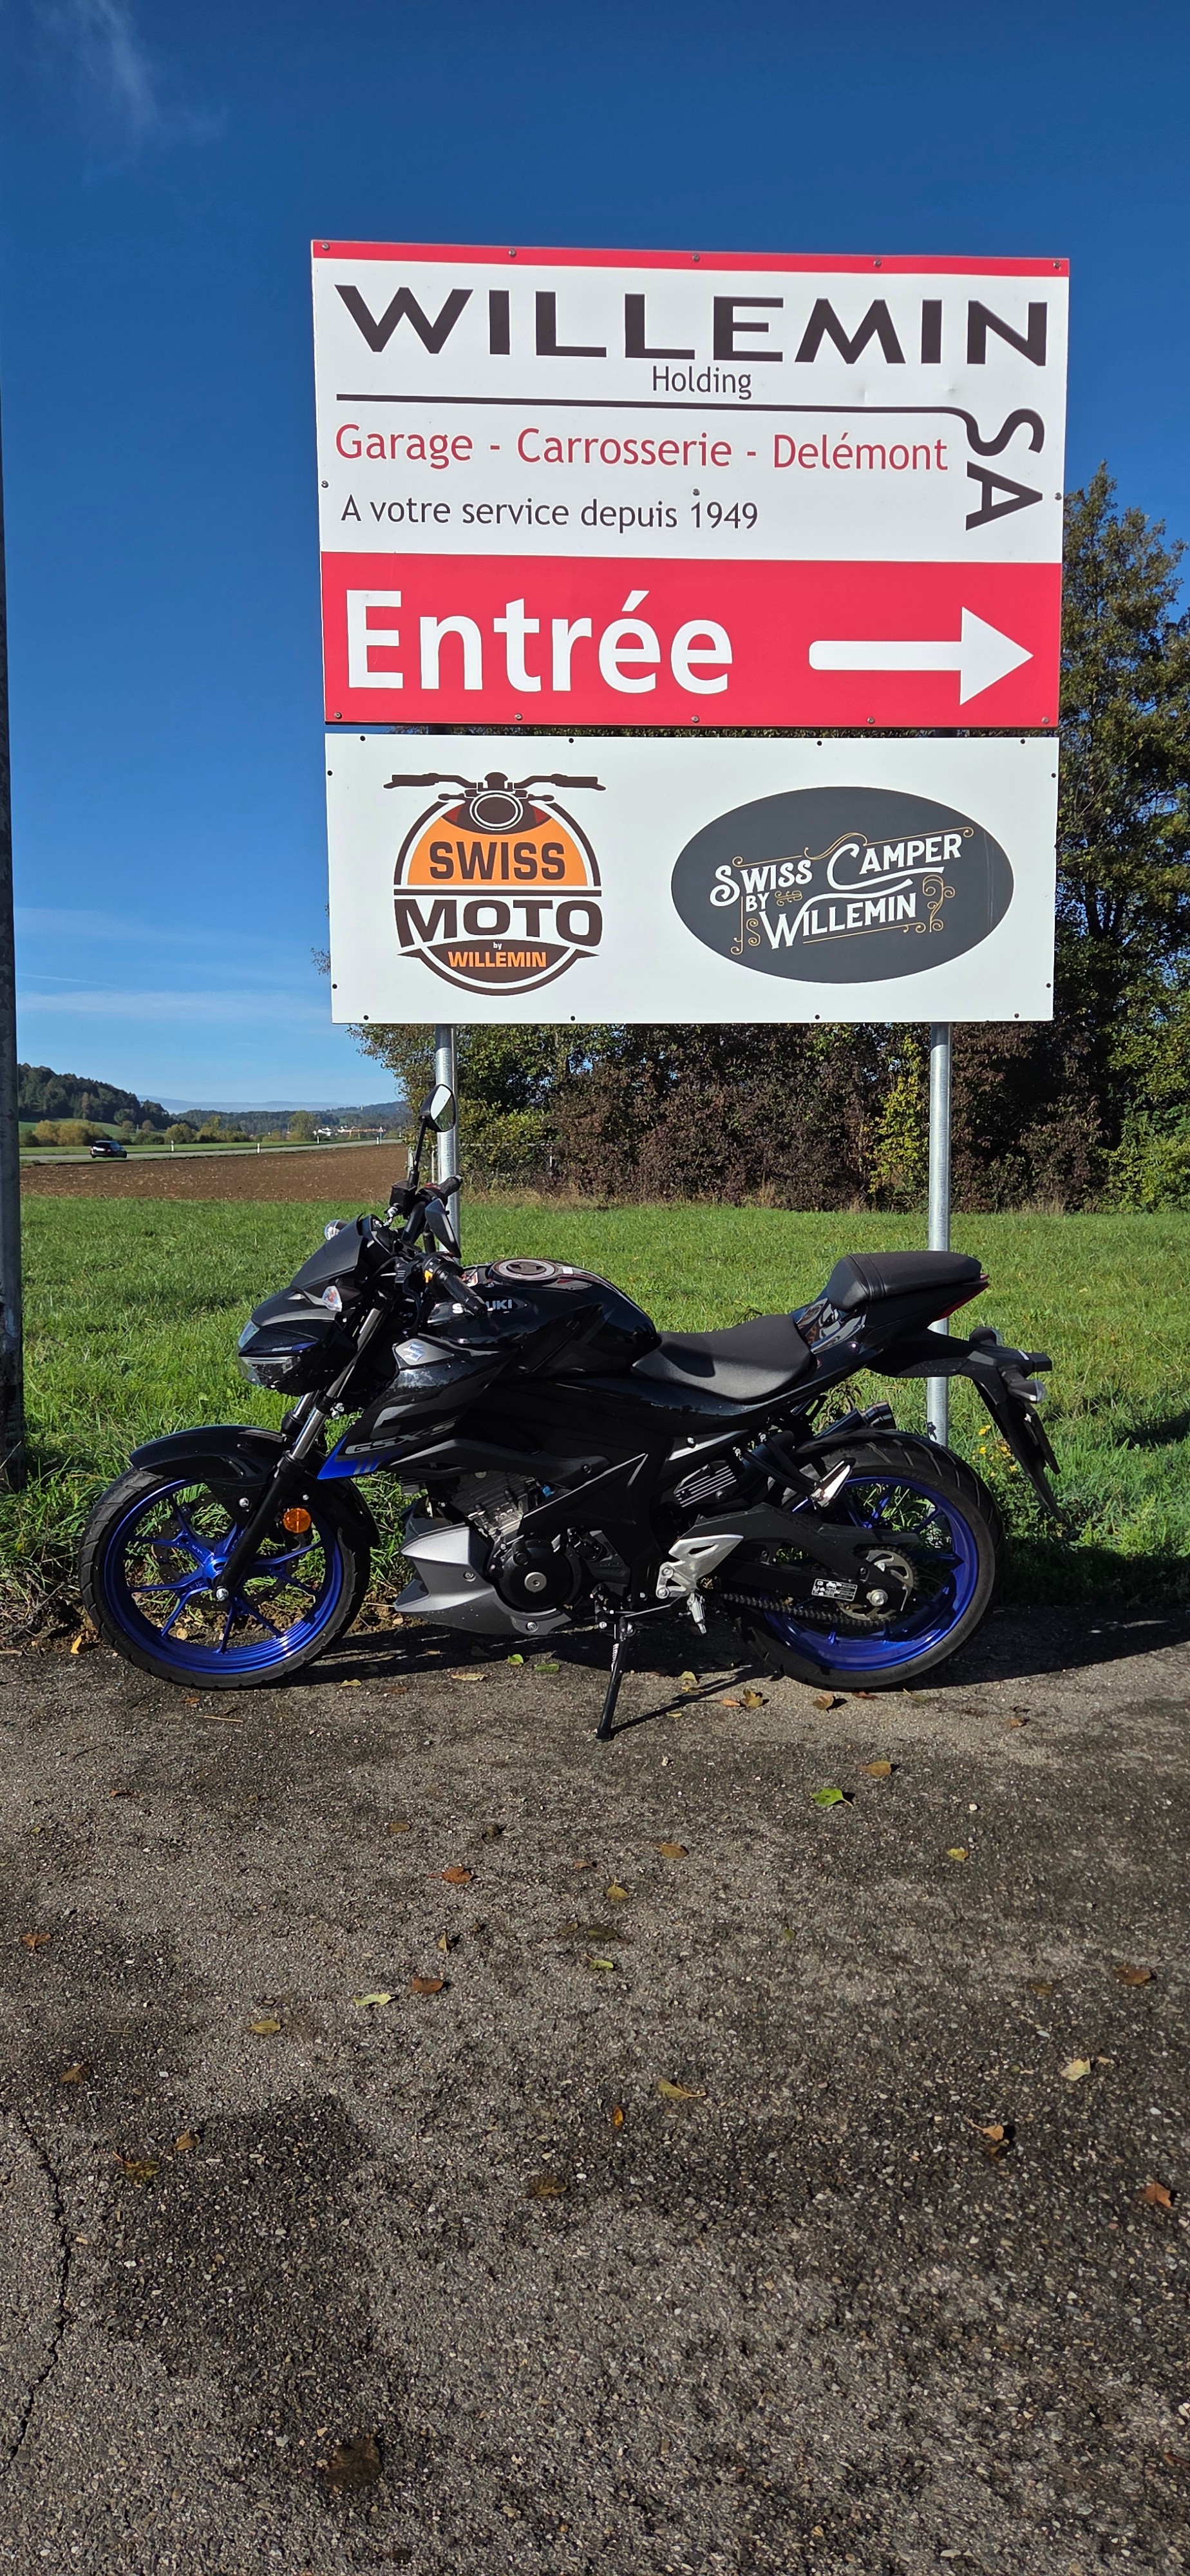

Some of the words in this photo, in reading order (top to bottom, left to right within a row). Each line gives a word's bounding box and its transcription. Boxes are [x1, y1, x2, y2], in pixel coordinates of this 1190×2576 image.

[335, 285, 1047, 366] WILLEMIN
[653, 366, 751, 400] Holding
[335, 424, 473, 469] Garage
[517, 428, 732, 467] Carrosserie
[773, 432, 948, 470] Delémont
[965, 408, 1045, 531] SA
[341, 495, 361, 522] A
[370, 497, 451, 524] votre
[462, 498, 569, 526] service
[581, 498, 677, 534] depuis
[691, 502, 759, 529] 1949
[346, 590, 732, 694] Entrée
[430, 841, 565, 880] SWISS
[746, 893, 770, 912] BY
[394, 899, 603, 948] MOTO
[448, 951, 547, 967] WILLEMIN
[493, 942, 502, 950] by
[453, 1299, 513, 1314] SUKI
